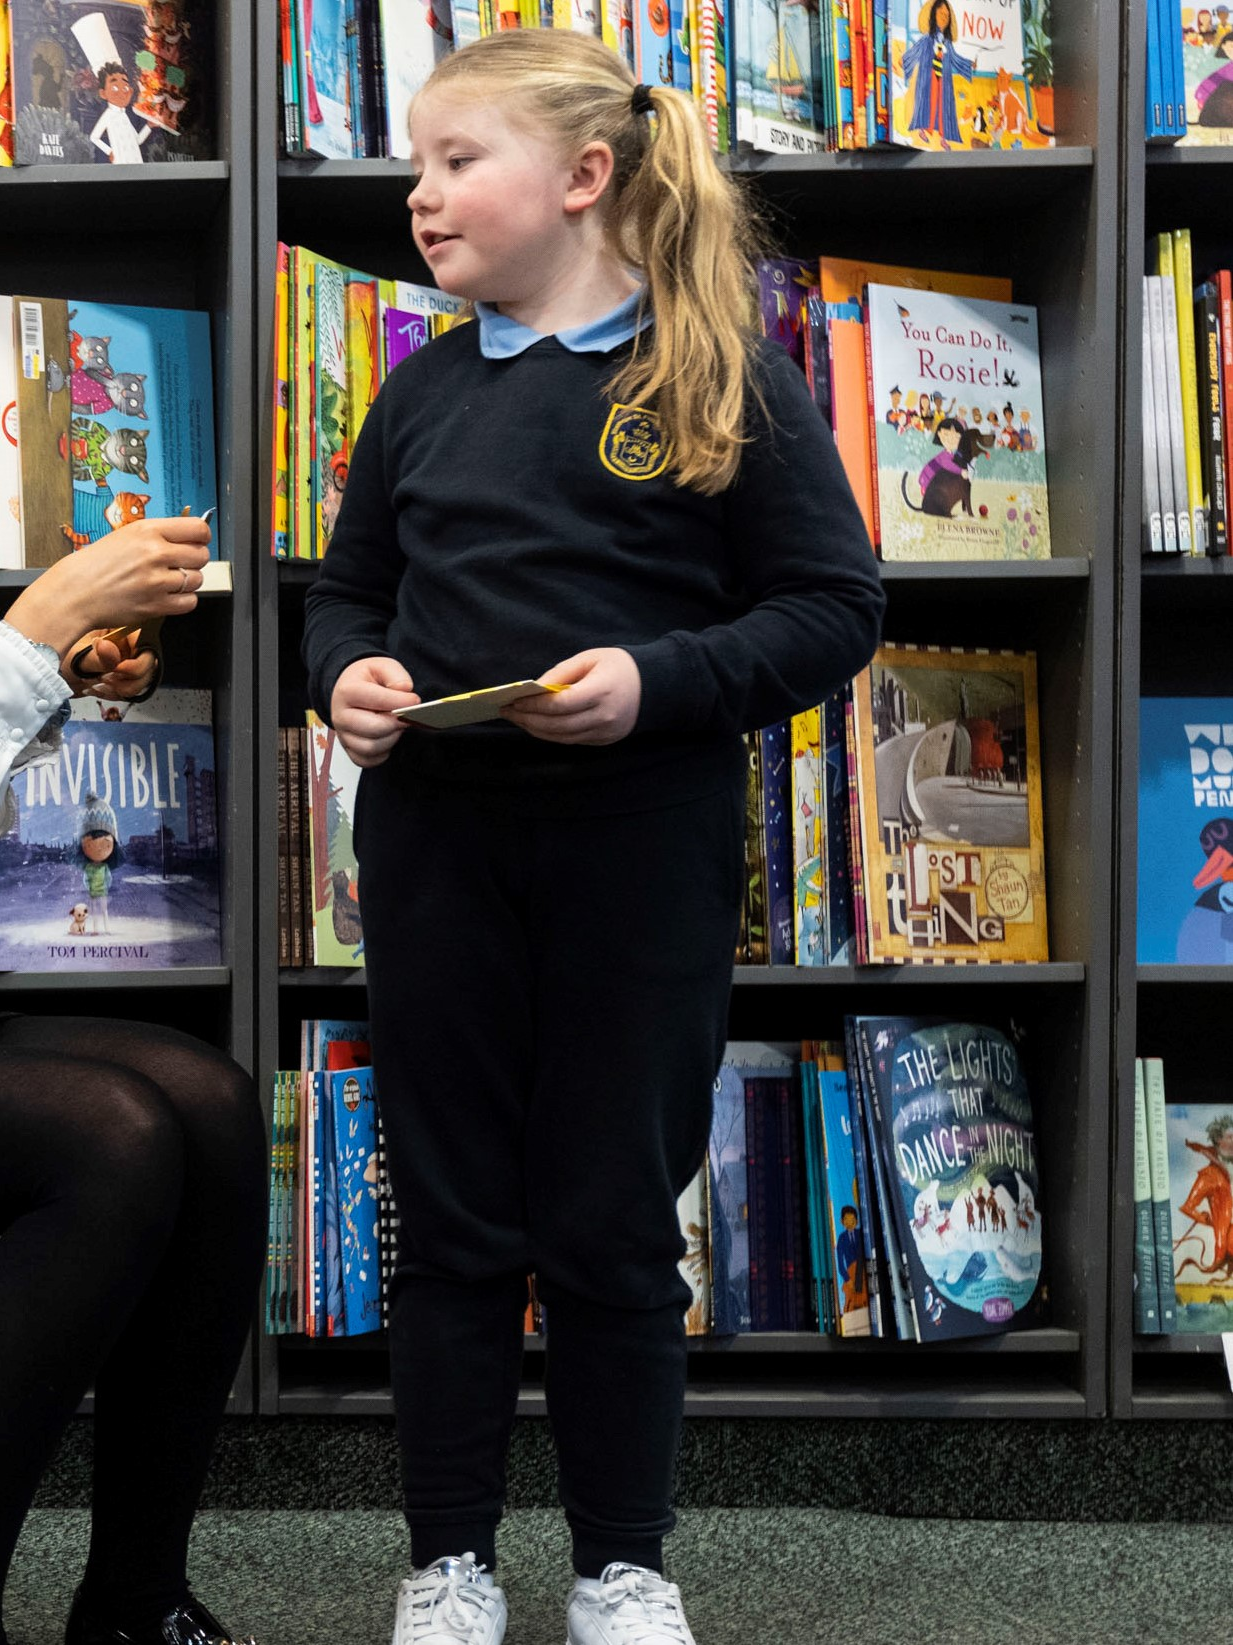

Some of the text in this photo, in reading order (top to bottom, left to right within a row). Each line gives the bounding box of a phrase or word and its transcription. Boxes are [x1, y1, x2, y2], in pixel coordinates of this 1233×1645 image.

[962, 12, 1005, 41] NOW
[407, 292, 425, 308] THE
[901, 321, 1013, 354] You Can Do It,
[916, 348, 1000, 387] Rosie!
[965, 524, 1000, 537] BROWNE
[25, 741, 181, 809] INVISIBLE
[290, 783, 300, 837] ARRIVAL
[278, 856, 287, 889] SHAUN
[291, 856, 300, 889] SHAUN
[989, 880, 1024, 897] Shaun
[279, 892, 287, 914] TAN
[293, 892, 301, 914] TAN
[998, 898, 1020, 912] Tan
[48, 945, 149, 960] TOM PERCIVAL
[897, 1044, 942, 1089] THE
[945, 1039, 1013, 1086] LIGHTS
[947, 1086, 984, 1119] THAT
[898, 1123, 1034, 1186] DANCE IN THE NIGHT
